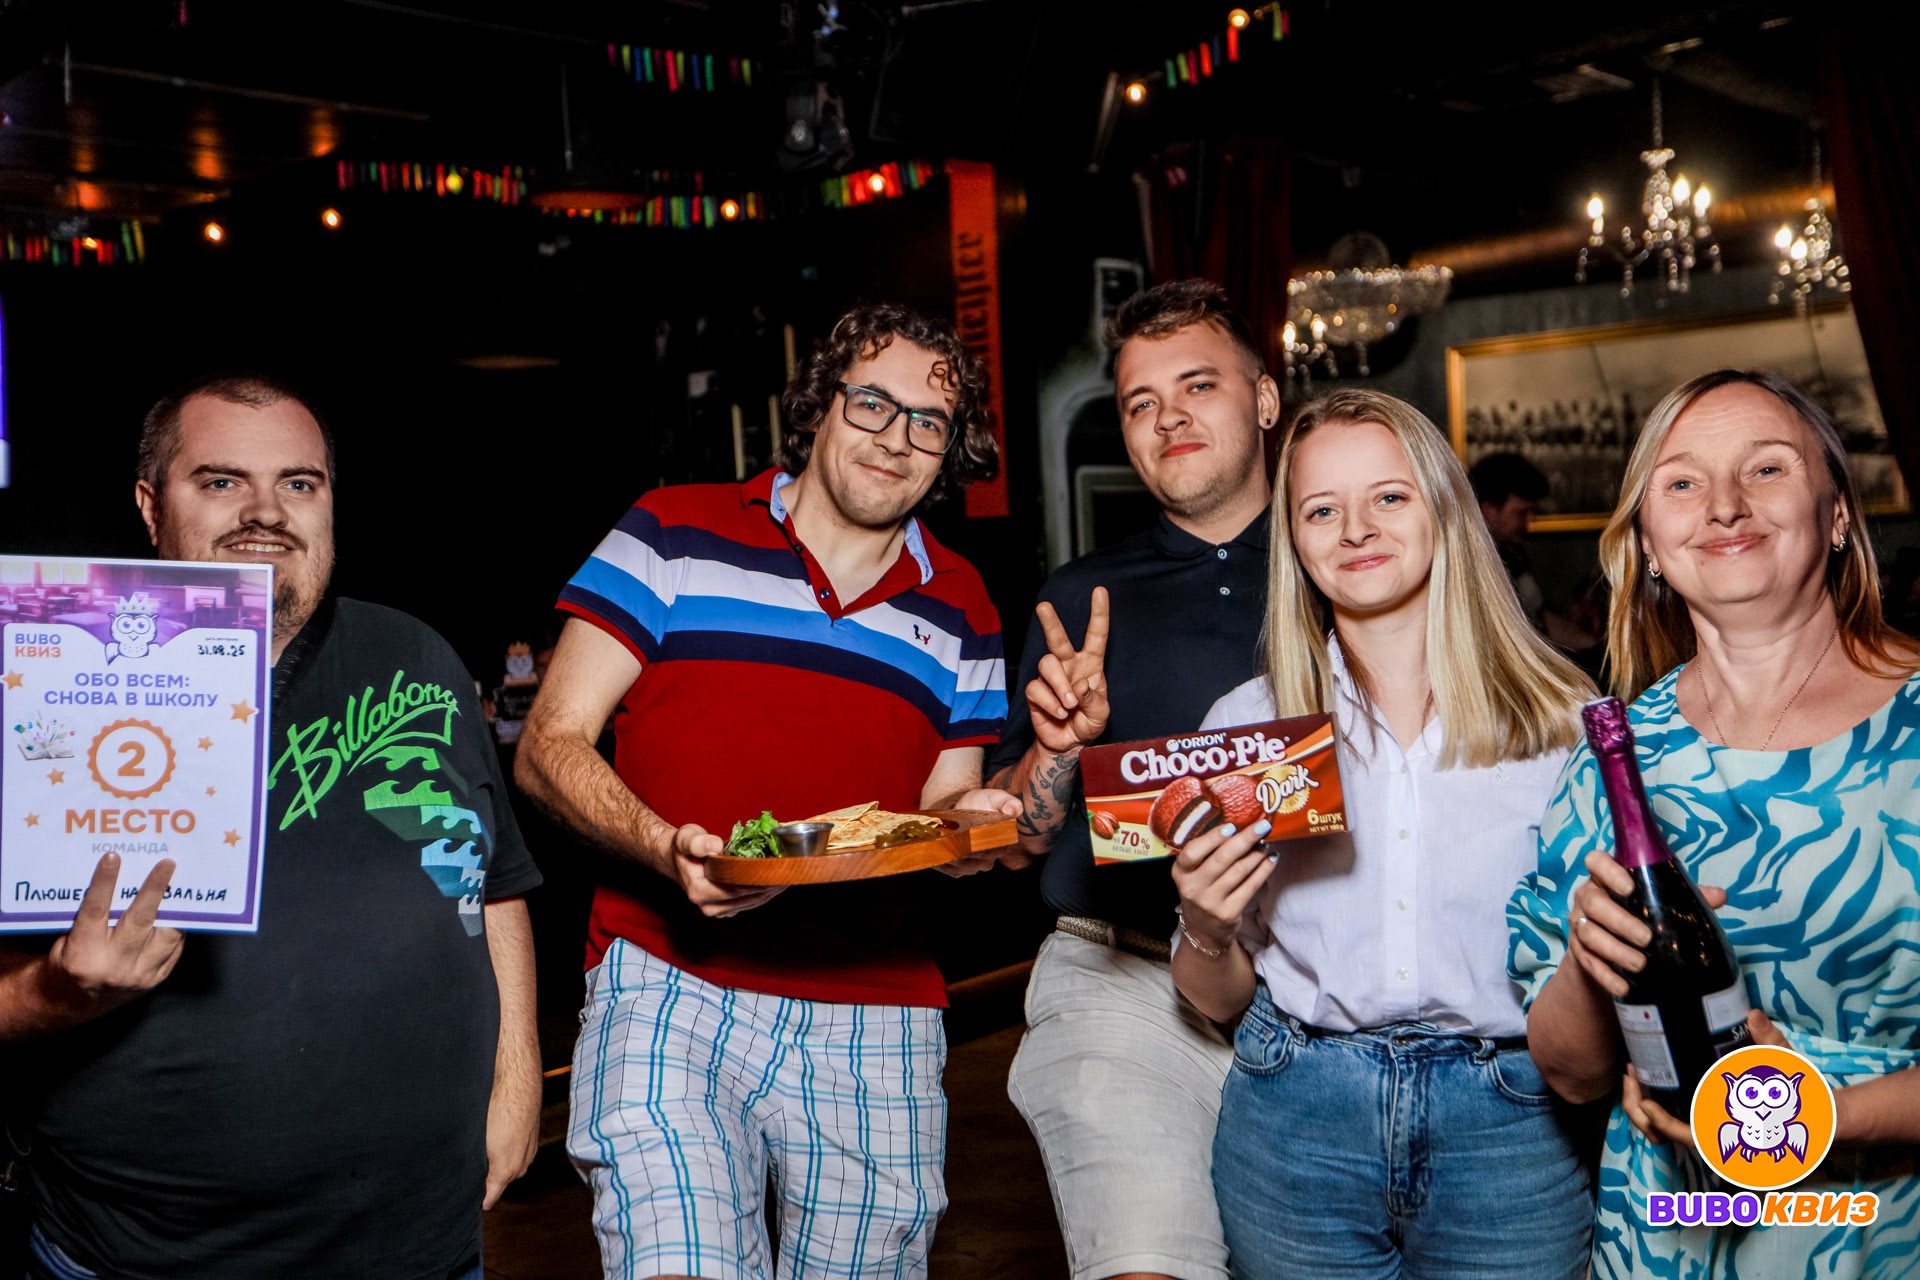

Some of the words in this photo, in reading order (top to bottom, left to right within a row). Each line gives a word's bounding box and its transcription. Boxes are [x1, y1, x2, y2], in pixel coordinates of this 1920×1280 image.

[14, 633, 61, 645] BUBO
[14, 646, 62, 658] КВИЗ
[198, 644, 245, 657] 31.08.25
[74, 673, 119, 687] ОБО
[126, 674, 190, 688] ВСЕМ:
[44, 691, 118, 705] СНОВА
[125, 692, 138, 706] В
[144, 693, 218, 707] ШКОЛУ
[1180, 733, 1227, 749] ORION
[117, 741, 145, 777] 2
[1256, 764, 1320, 814] Dark
[65, 808, 196, 834] МЕСТО
[1120, 830, 1151, 850] 70%
[92, 843, 169, 855] КОМАНДА
